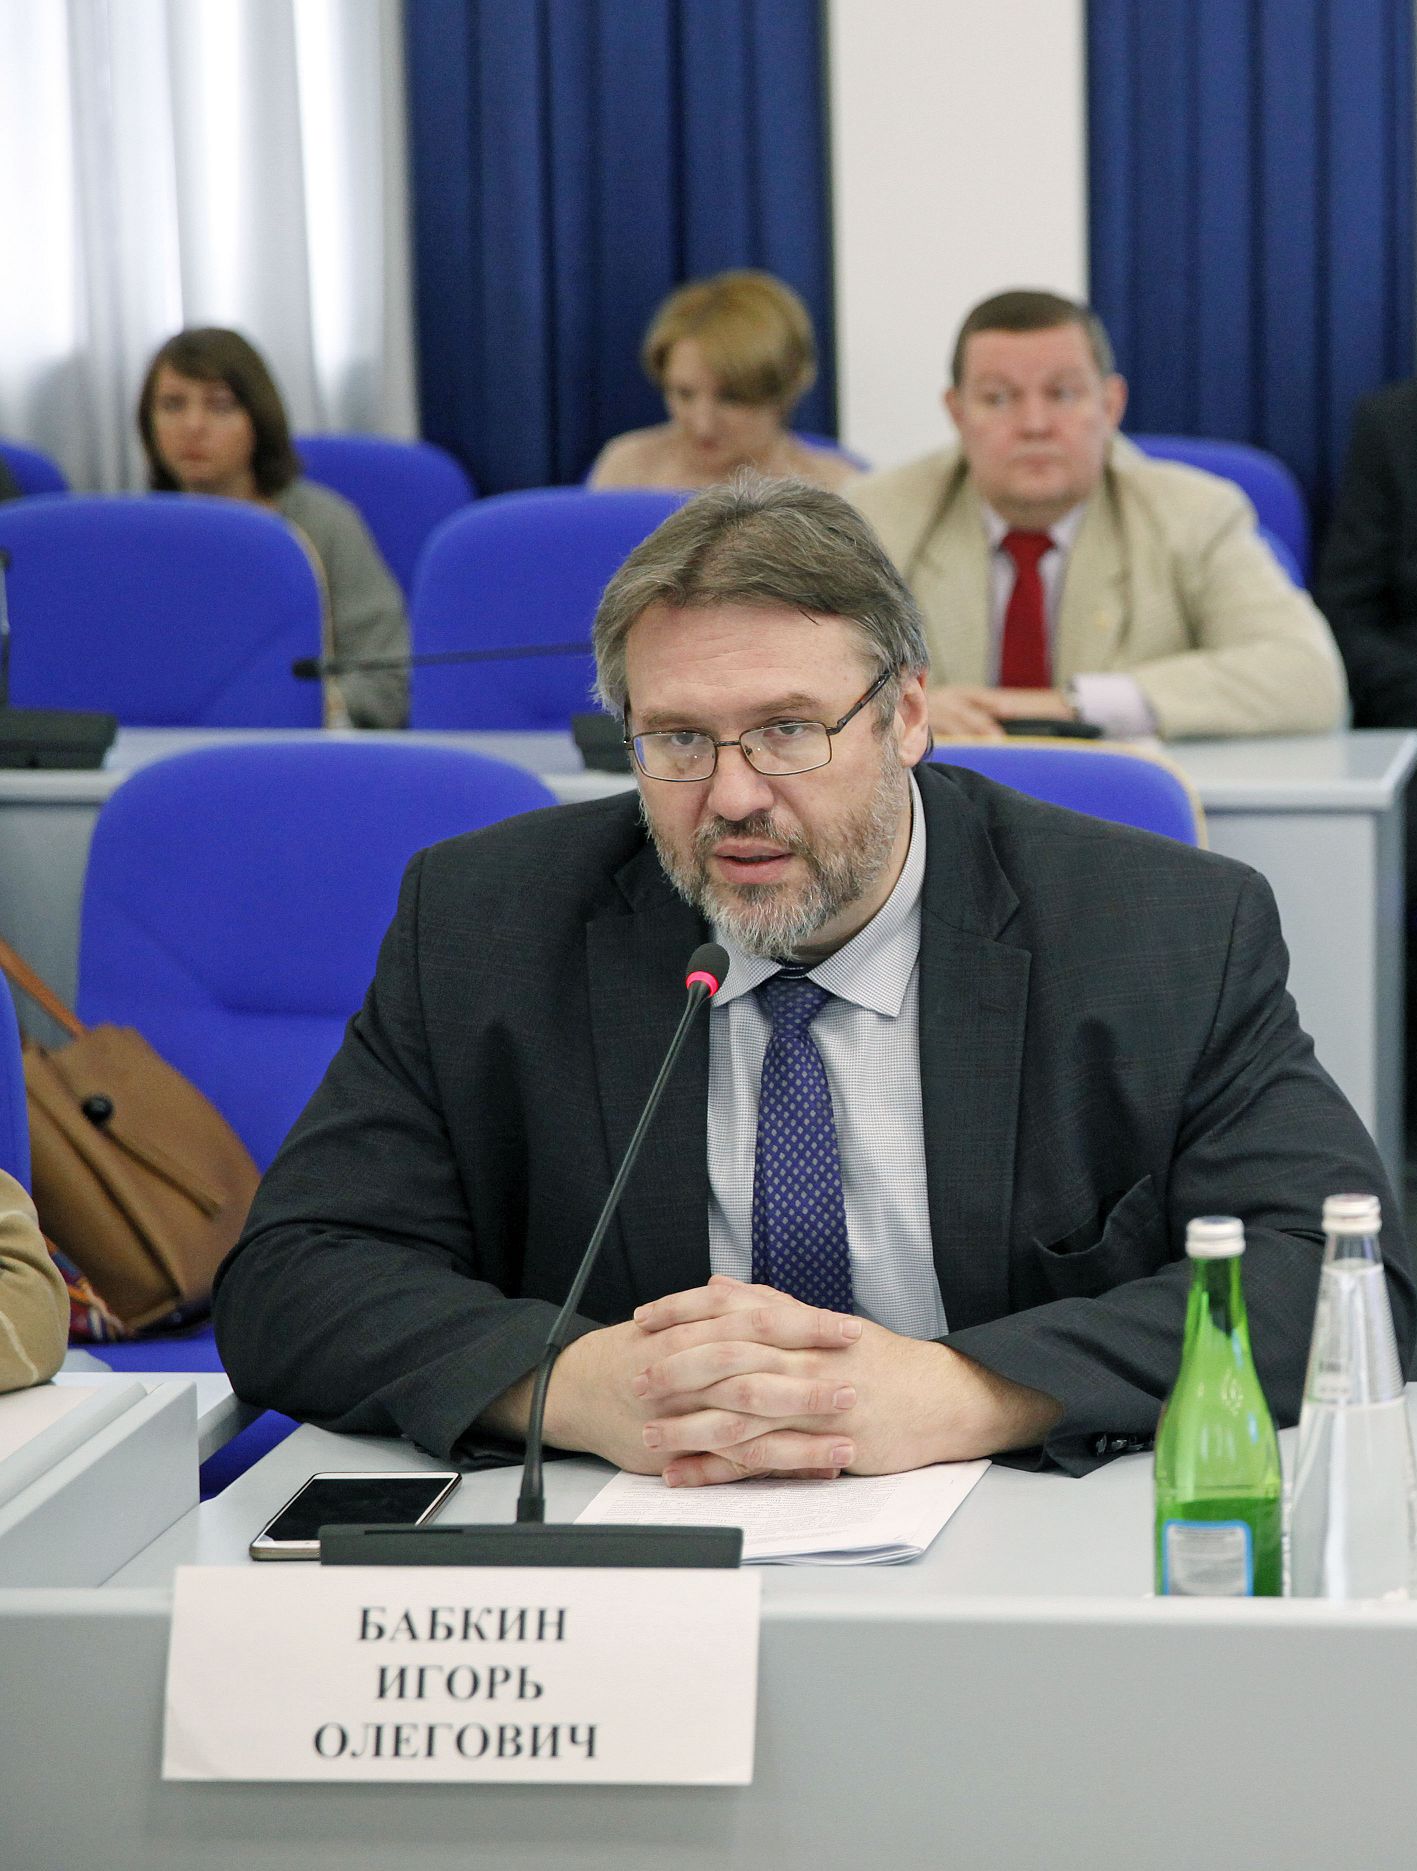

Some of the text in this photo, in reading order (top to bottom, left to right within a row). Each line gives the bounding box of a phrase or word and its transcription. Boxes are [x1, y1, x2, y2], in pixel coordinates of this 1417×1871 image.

[358, 1608, 567, 1642] БАБКИН
[375, 1667, 544, 1701] ИГОРЬ
[312, 1724, 598, 1759] ОЛЕГОВИЧ
